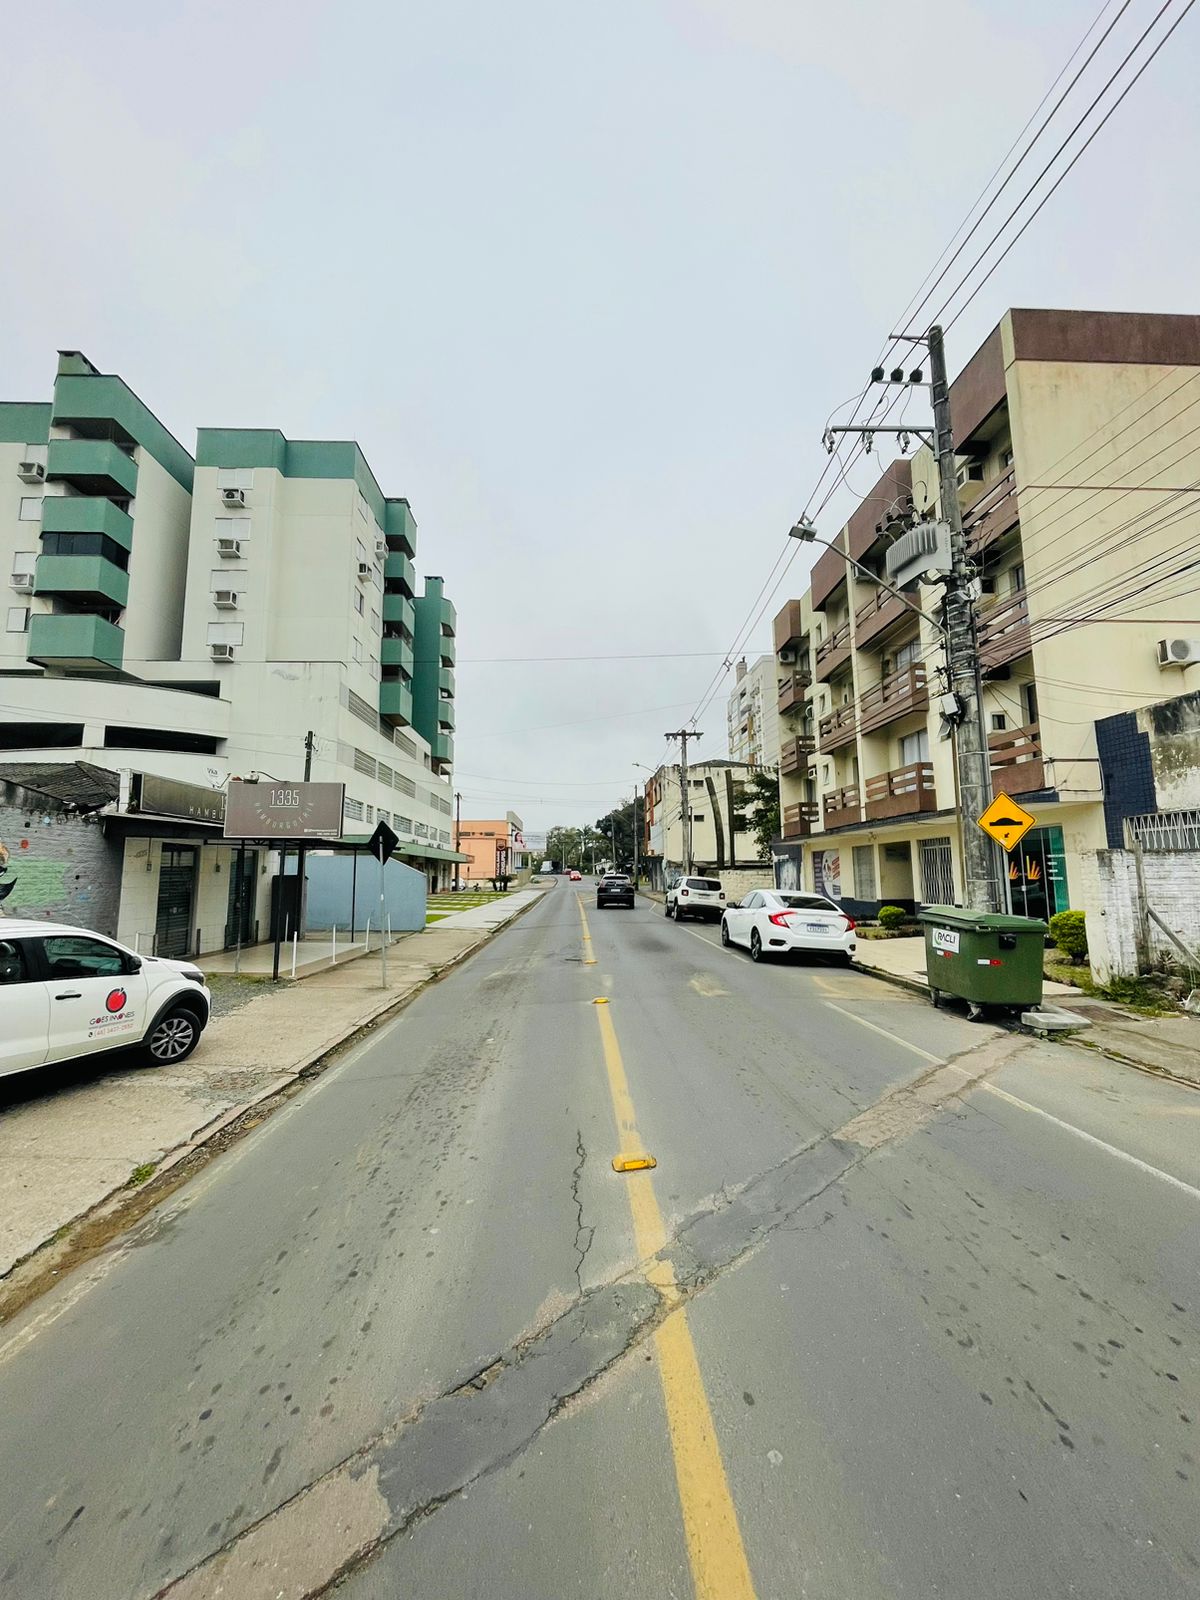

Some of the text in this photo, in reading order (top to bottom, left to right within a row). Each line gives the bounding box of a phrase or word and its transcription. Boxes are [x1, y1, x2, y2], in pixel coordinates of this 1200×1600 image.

[270, 789, 300, 805] 1335
[189, 806, 224, 820] HAMBU
[937, 932, 956, 944] RACLI
